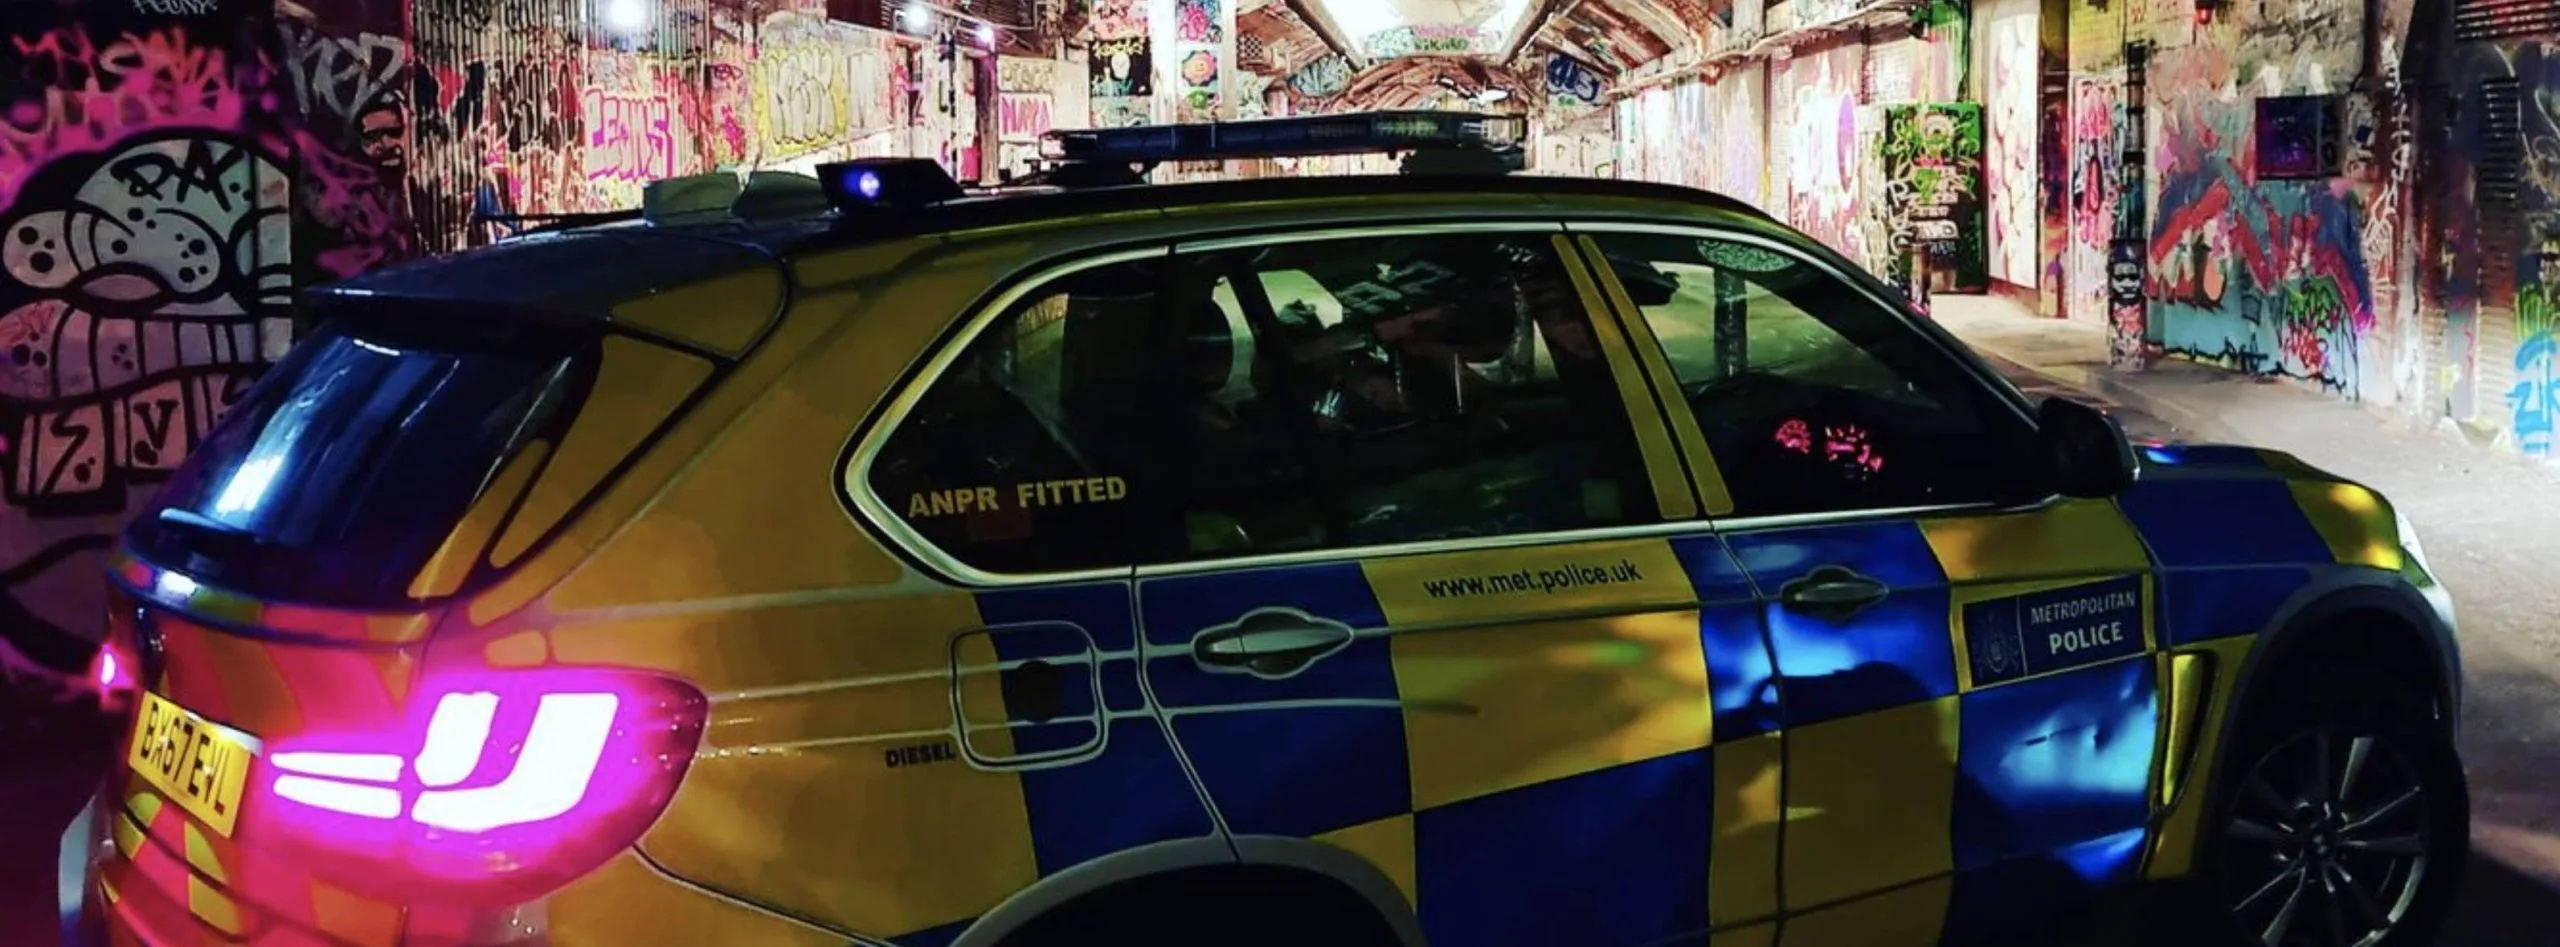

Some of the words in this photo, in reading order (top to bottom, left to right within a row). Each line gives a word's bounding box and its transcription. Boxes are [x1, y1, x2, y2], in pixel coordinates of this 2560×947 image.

[908, 486, 1000, 518] ANPR
[1017, 476, 1127, 508] FITTED
[1424, 559, 1643, 598] www.met.police.uk
[2030, 592, 2136, 624] METROPOLITAN
[2049, 622, 2123, 655] POLICE
[885, 741, 957, 768] DIESEL
